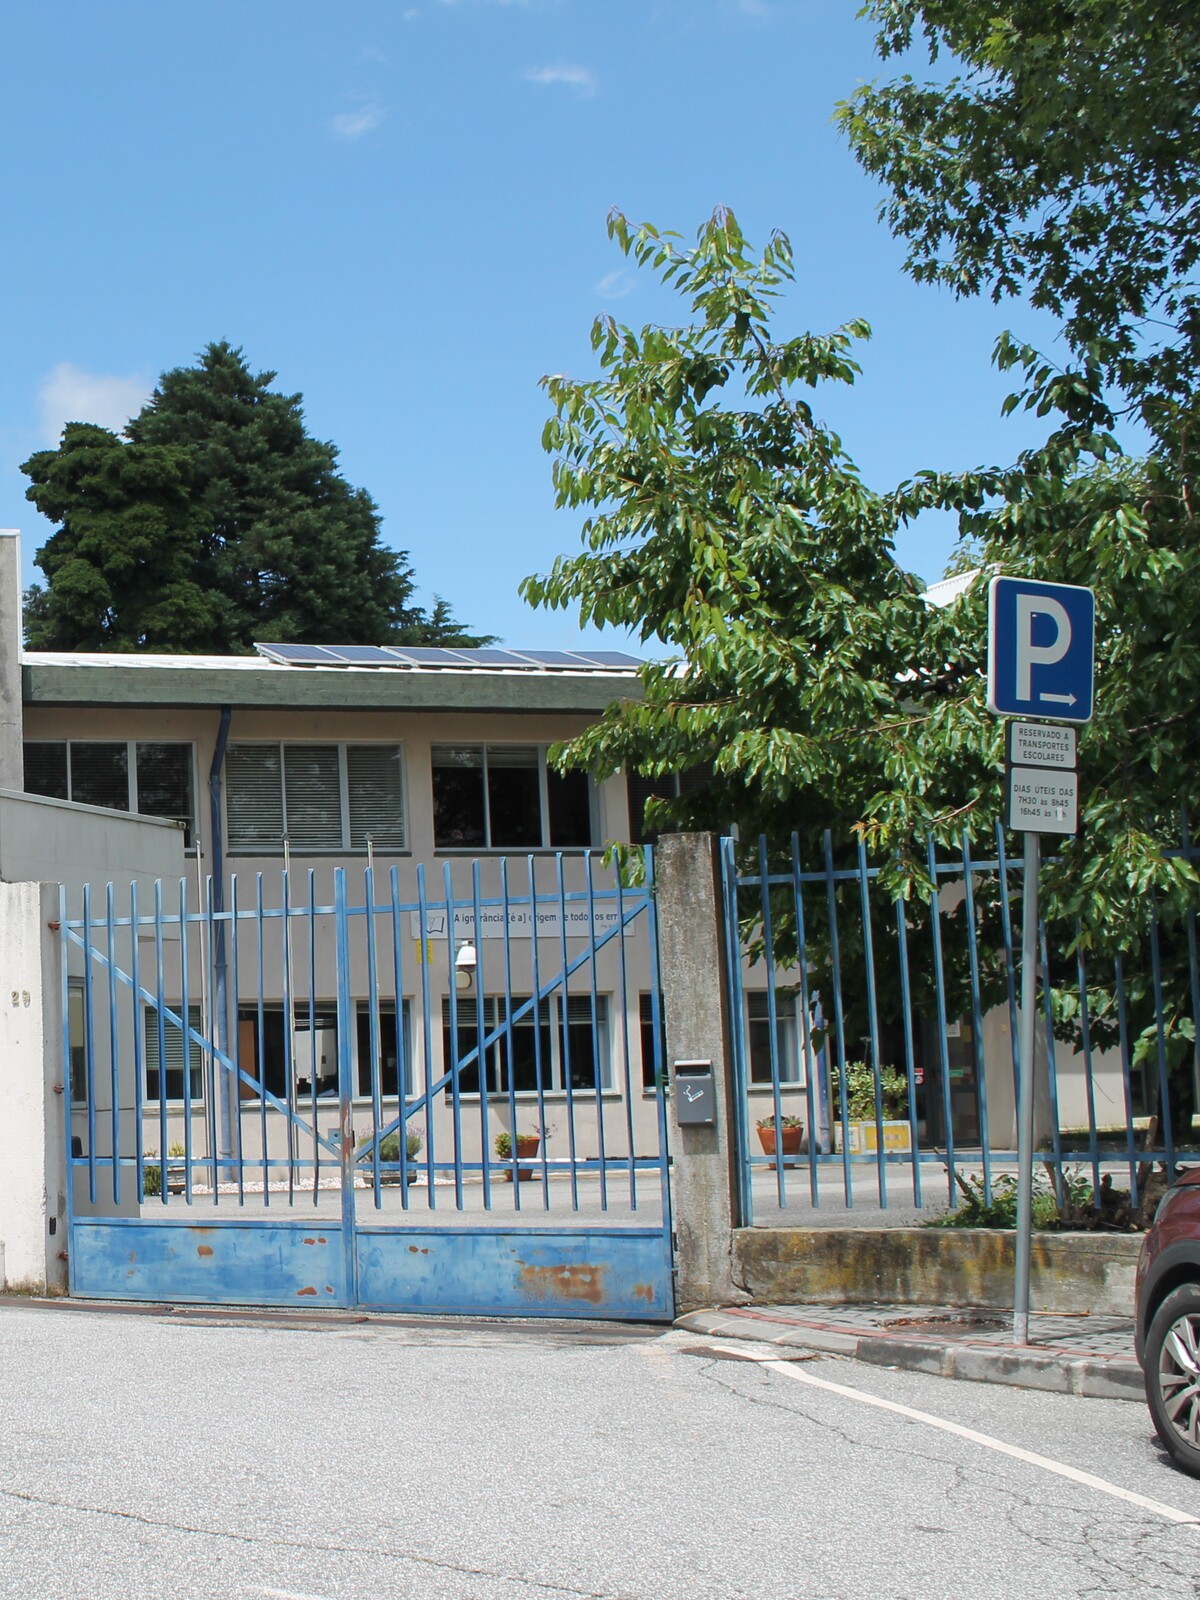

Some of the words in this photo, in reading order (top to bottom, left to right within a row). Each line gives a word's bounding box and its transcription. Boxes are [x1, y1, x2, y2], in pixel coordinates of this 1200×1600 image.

[1016, 594, 1072, 701] P
[1018, 728, 1061, 740] RESERVADO
[1018, 739, 1069, 752] TRANSPORTES
[1023, 751, 1065, 762] ESCOLARES
[1014, 784, 1031, 793] DIAS
[1059, 788, 1074, 797] DAS
[1018, 796, 1037, 805] 7H30
[1055, 810, 1067, 818] 1h
[454, 913, 460, 922] A
[462, 912, 506, 925] ignrância
[571, 911, 593, 921] todo
[595, 913, 604, 921] os
[11, 989, 30, 1008] 29
